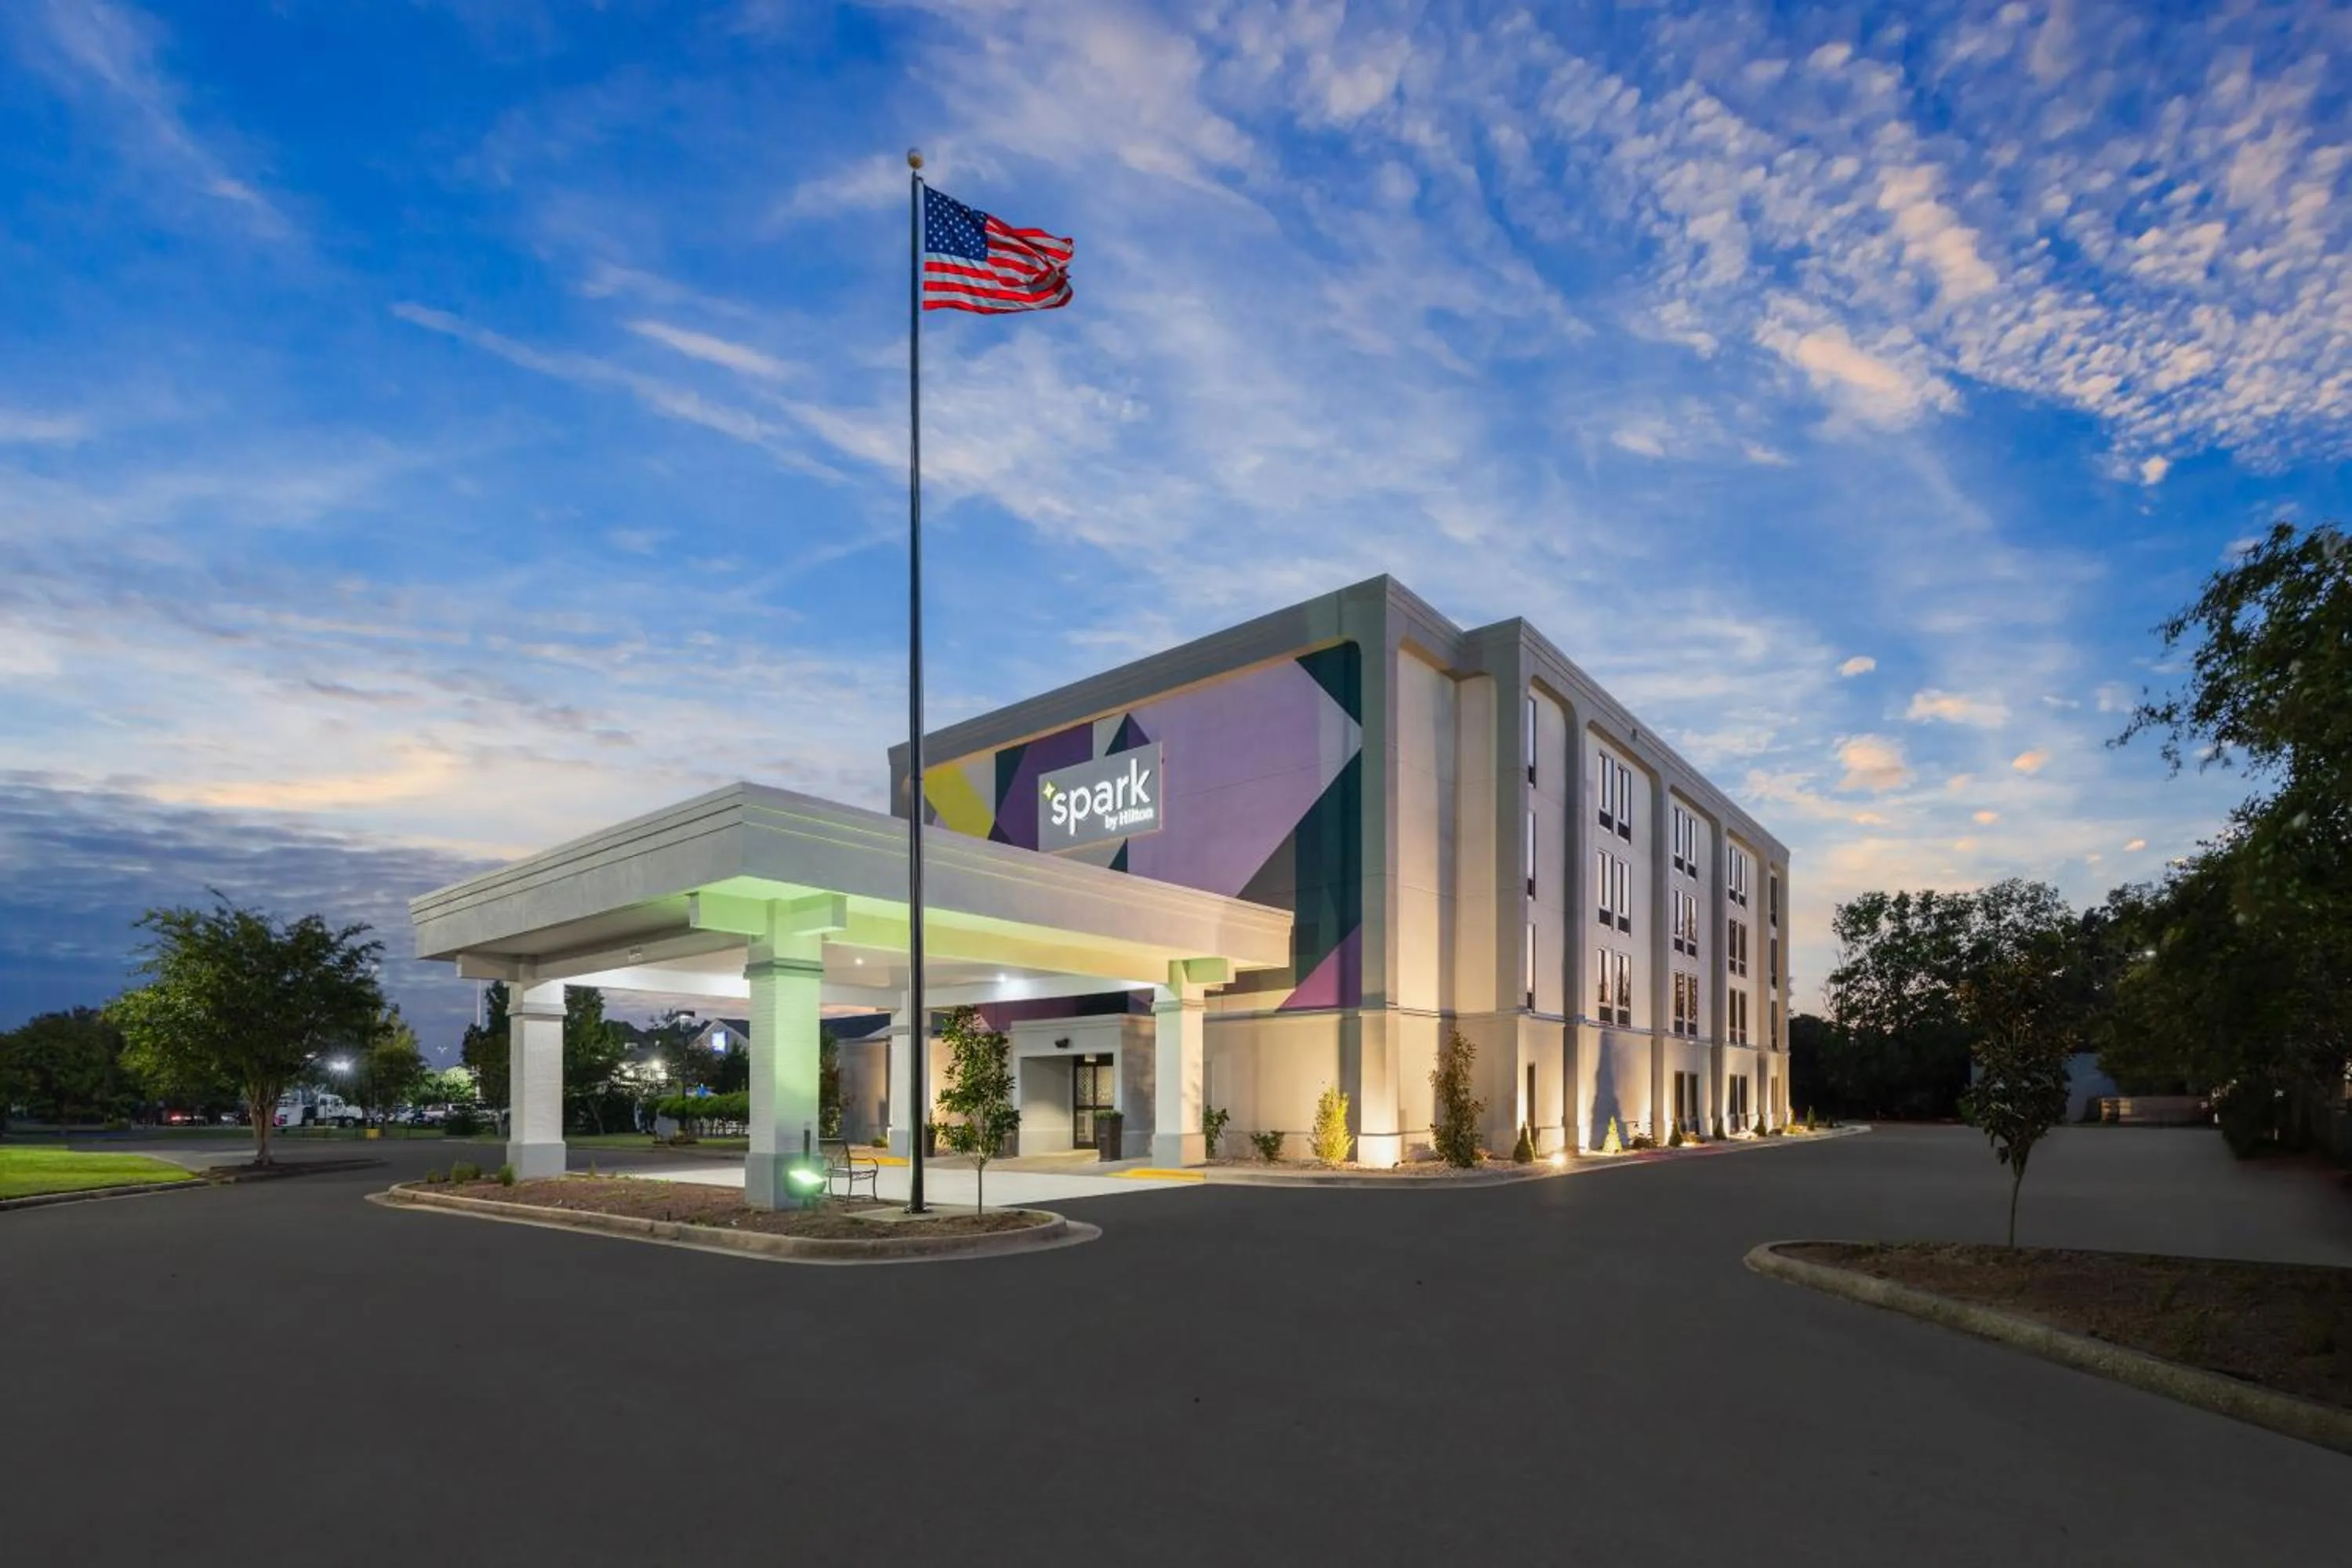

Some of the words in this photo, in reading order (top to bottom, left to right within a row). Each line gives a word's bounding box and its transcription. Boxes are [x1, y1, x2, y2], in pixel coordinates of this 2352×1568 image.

[1051, 758, 1151, 837] spark
[1105, 815, 1118, 831] by
[1119, 808, 1153, 825] Hilton
